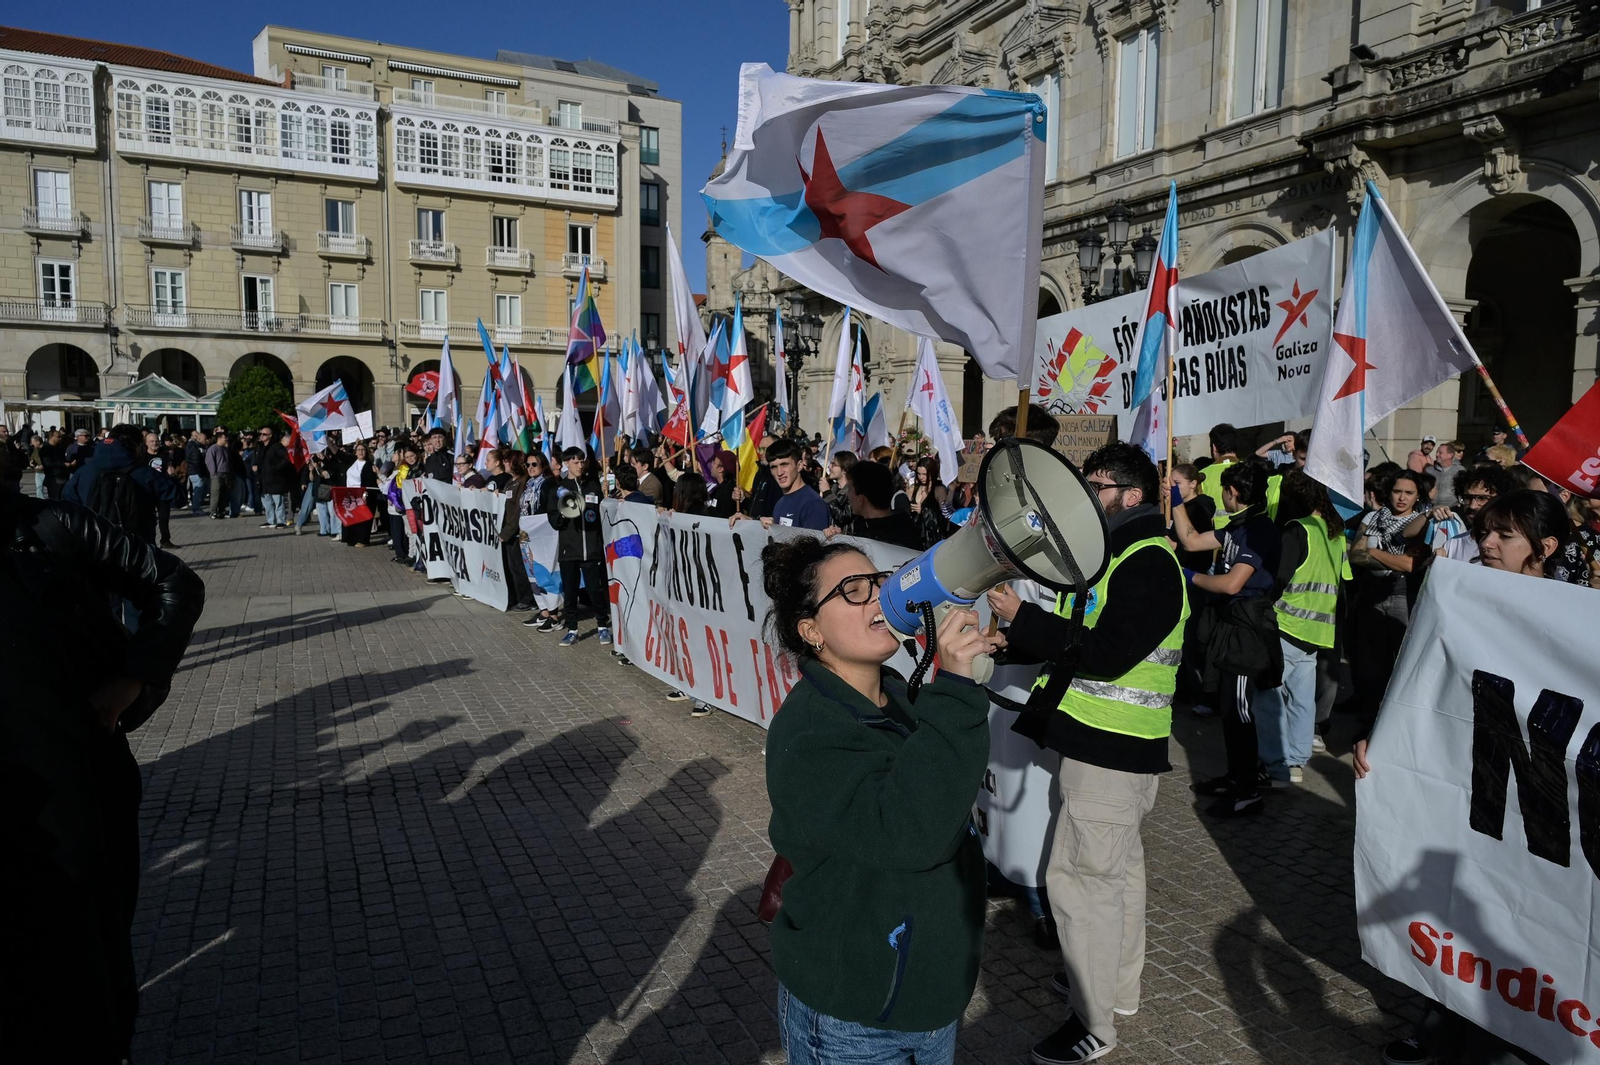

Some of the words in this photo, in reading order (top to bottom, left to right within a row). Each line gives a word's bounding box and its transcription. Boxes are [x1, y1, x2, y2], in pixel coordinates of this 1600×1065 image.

[1225, 199, 1241, 214] DE
[1250, 194, 1267, 208] LA
[1205, 341, 1247, 394] RÚAS
[1276, 340, 1318, 361] Galiza
[1277, 364, 1311, 382] Nova
[1054, 434, 1077, 447] NON
[1078, 436, 1103, 447] MANDAN
[1567, 446, 1600, 493] ES
[442, 502, 500, 550] FASCISTAS
[733, 531, 755, 622] E
[704, 624, 738, 707] DE
